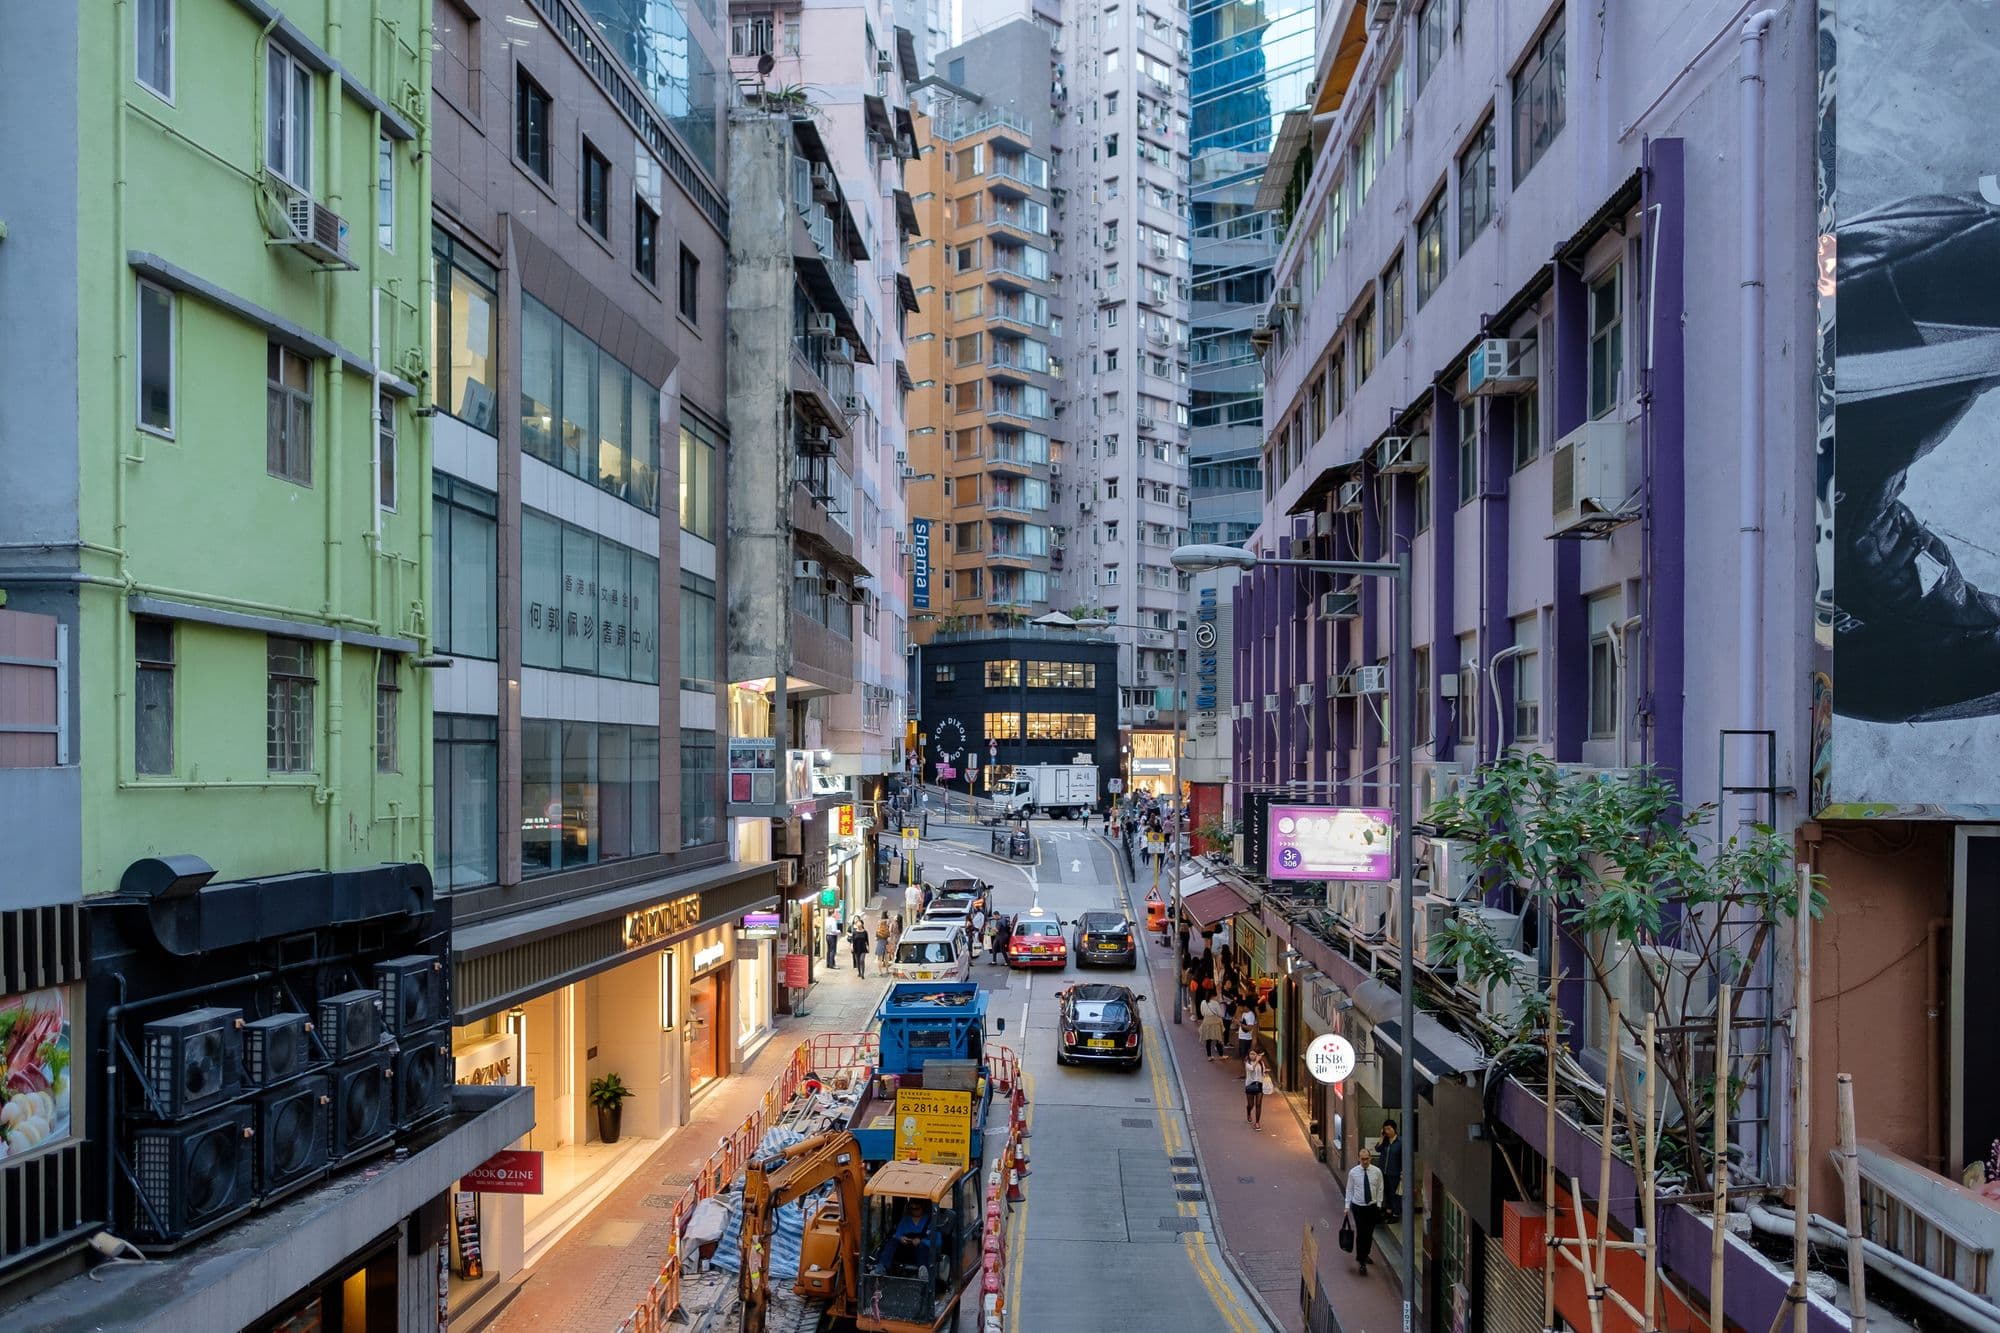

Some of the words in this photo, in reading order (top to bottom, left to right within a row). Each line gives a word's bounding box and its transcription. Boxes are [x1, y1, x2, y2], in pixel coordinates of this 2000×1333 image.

[916, 524, 929, 588] shama
[934, 720, 946, 740] TOM
[947, 717, 967, 742] DIXON
[936, 744, 965, 761] LONON
[913, 1103, 939, 1113] 2814
[943, 1104, 969, 1115] 3443
